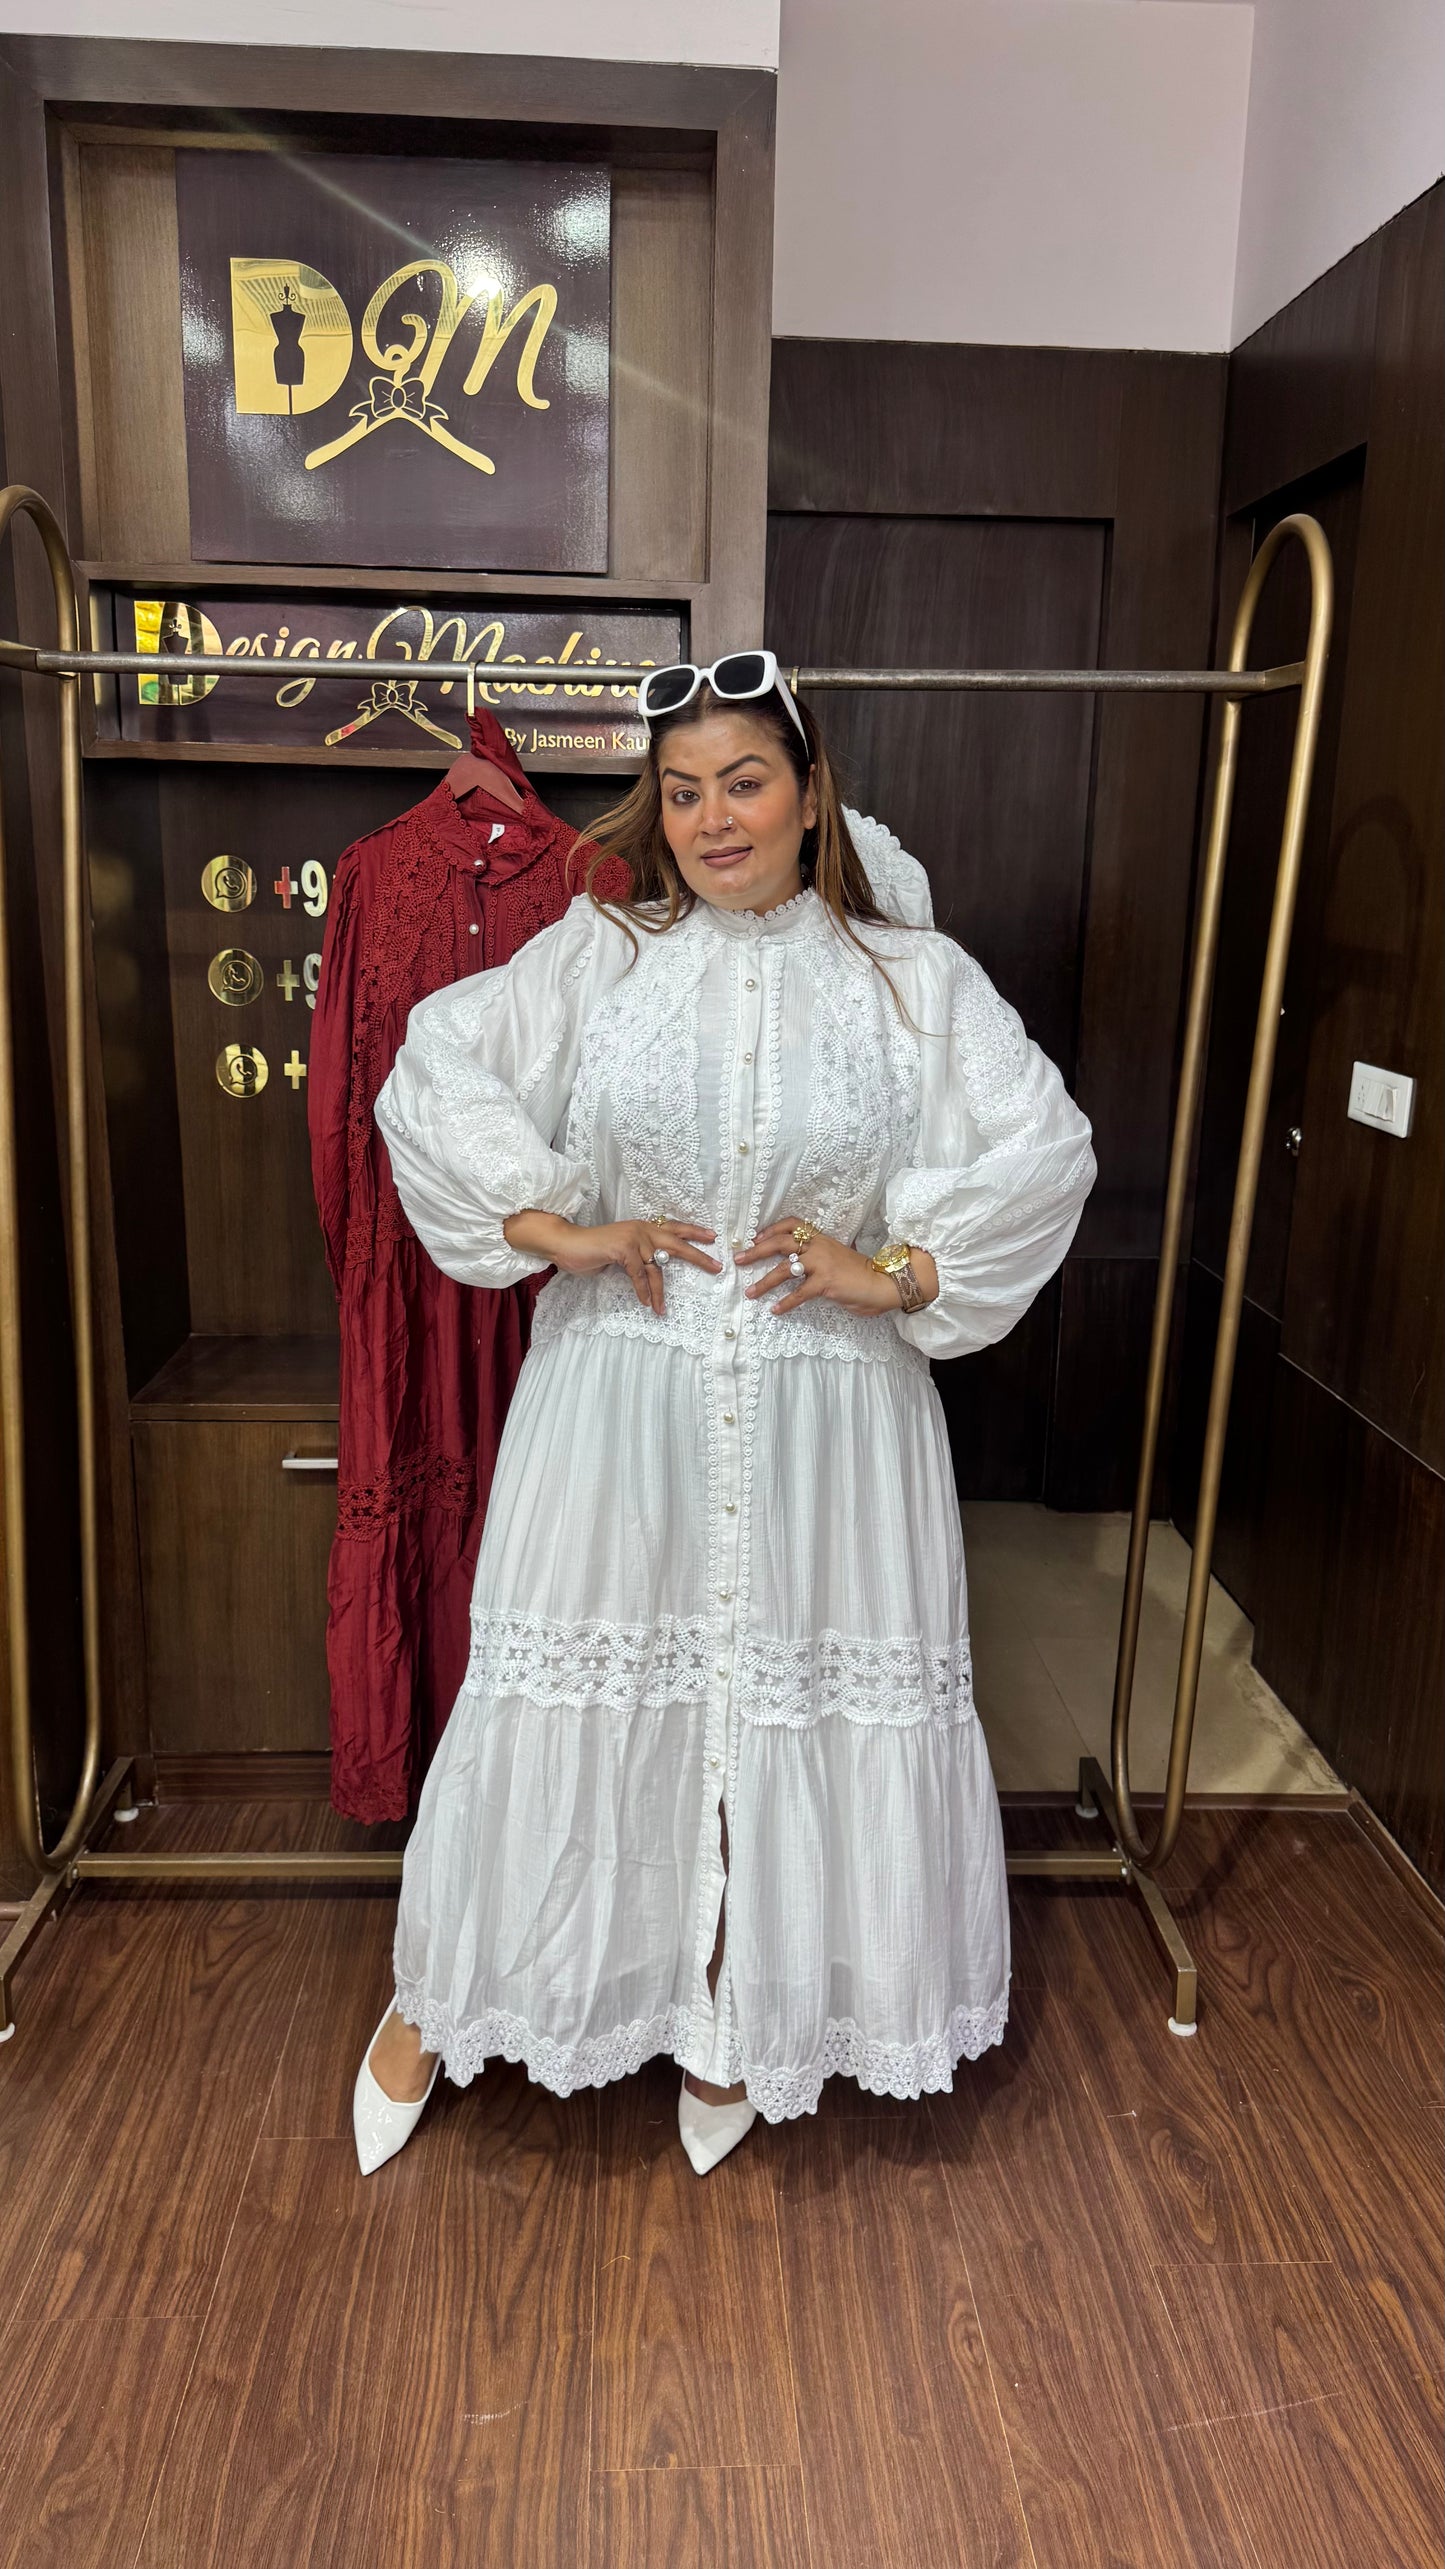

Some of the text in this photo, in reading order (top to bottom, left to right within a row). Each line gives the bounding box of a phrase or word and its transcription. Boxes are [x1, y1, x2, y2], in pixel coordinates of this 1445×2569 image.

[366, 605, 656, 705] Machin
[504, 727, 527, 752] By
[530, 728, 606, 753] Jasmeen
[274, 860, 336, 918] +9
